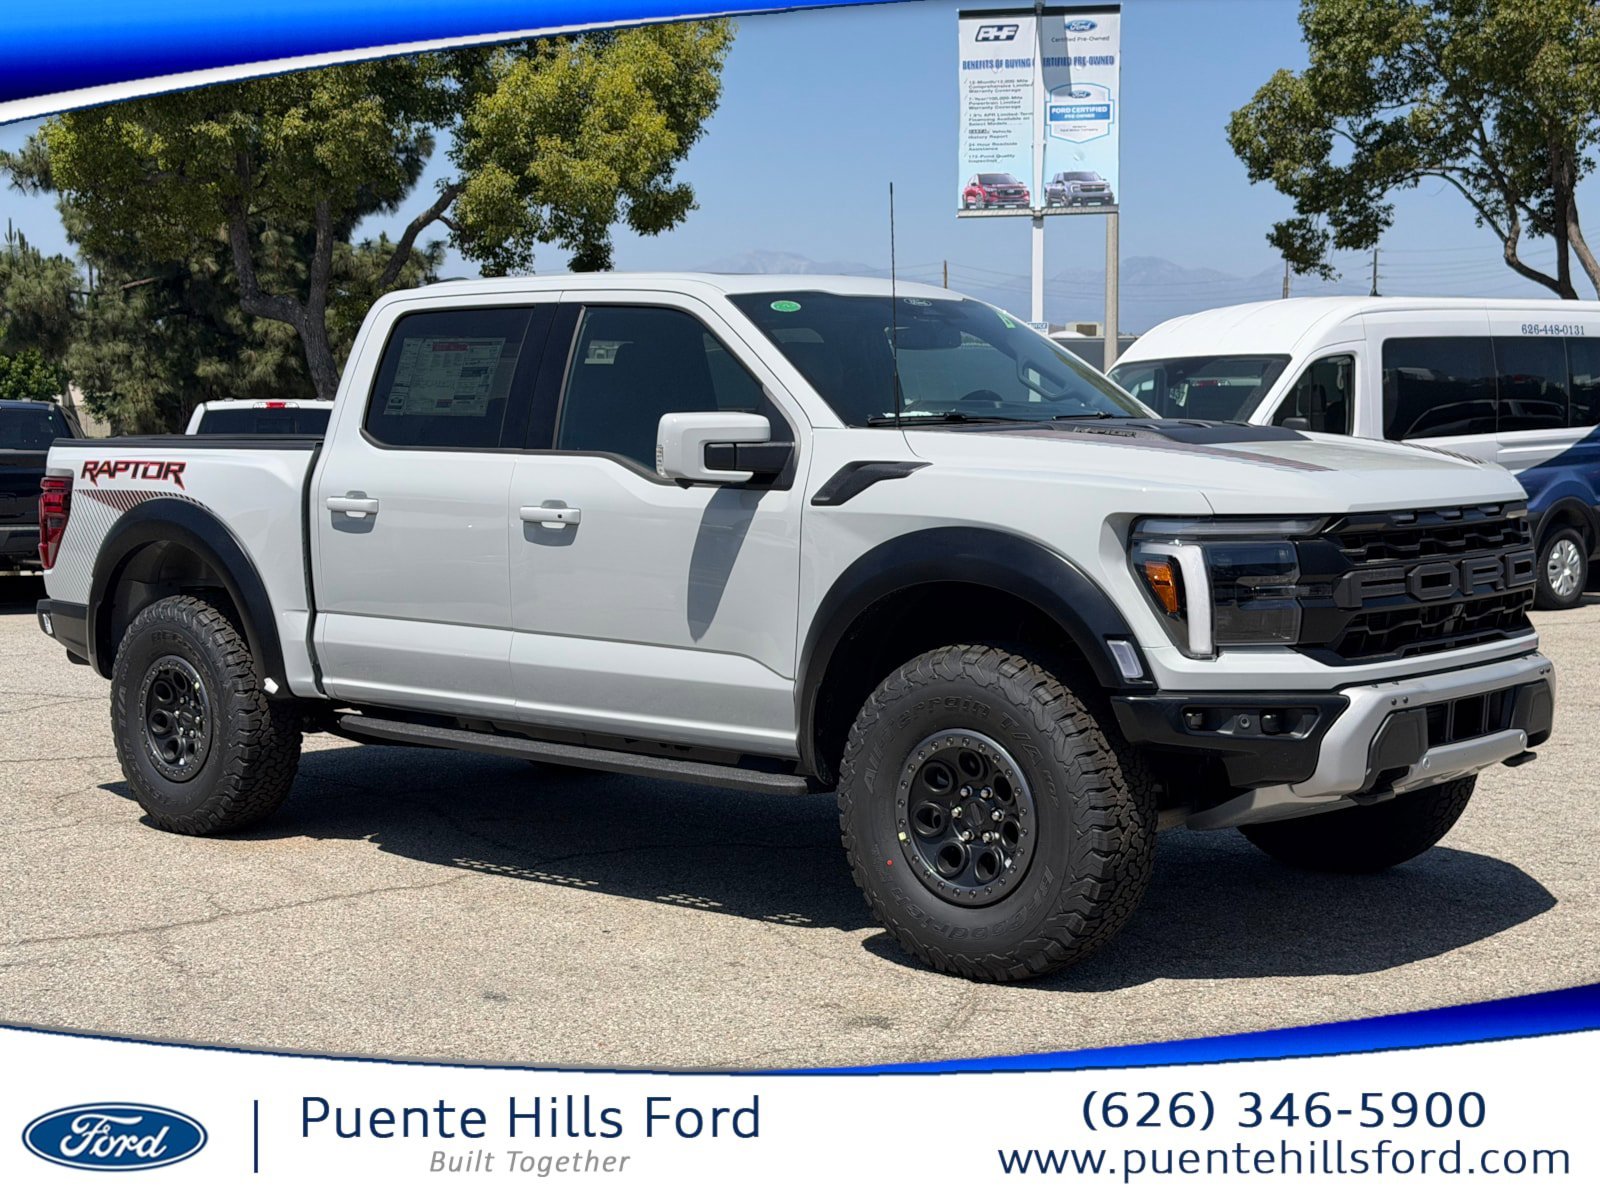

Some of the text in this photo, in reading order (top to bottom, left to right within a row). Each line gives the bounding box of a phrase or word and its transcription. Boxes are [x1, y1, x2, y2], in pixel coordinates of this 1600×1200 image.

[977, 26, 1018, 40] PHF
[962, 59, 994, 70] BENEFITS
[995, 59, 1004, 69] OF
[1004, 58, 1031, 69] BUYING
[1073, 55, 1115, 67] PRE-OWNED
[1521, 323, 1586, 336] 626-448-0131
[81, 460, 186, 491] RAPTOR
[1333, 550, 1538, 609] FORD
